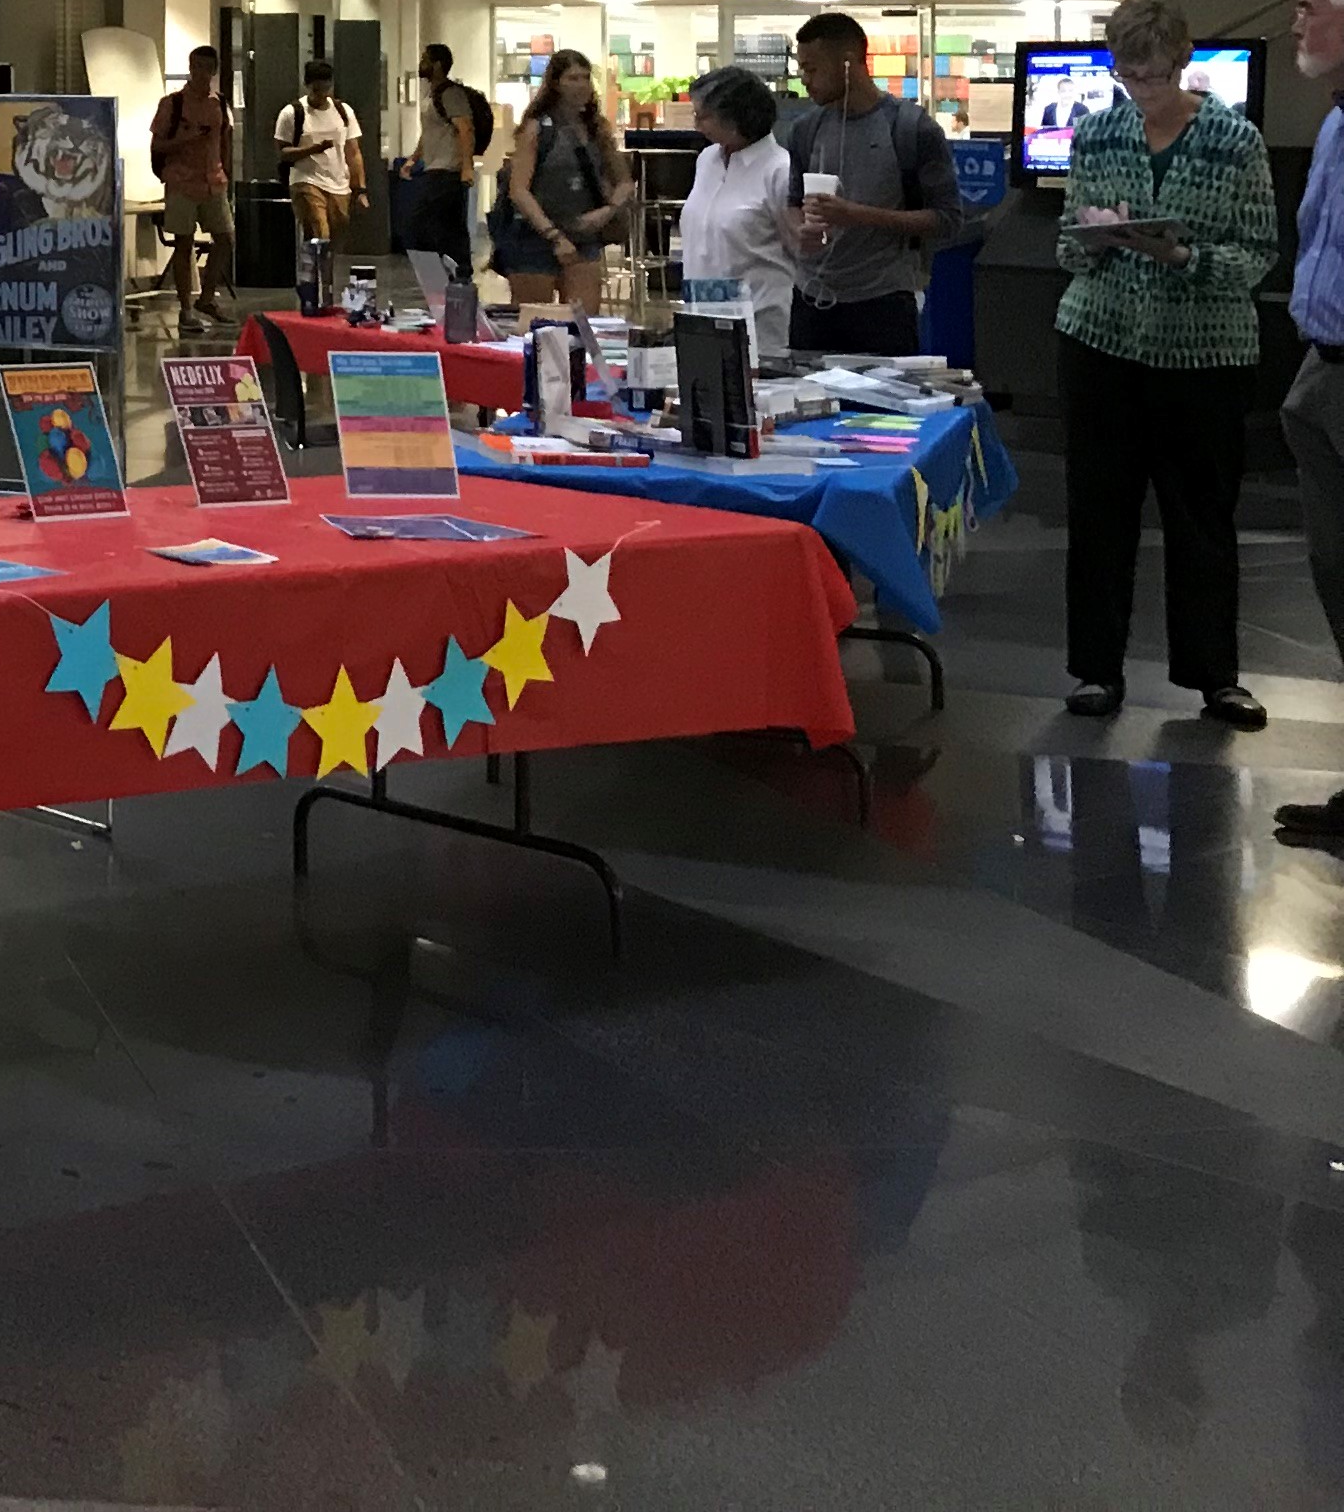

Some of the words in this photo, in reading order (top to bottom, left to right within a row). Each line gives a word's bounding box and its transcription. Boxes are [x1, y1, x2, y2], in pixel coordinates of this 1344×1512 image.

[56, 218, 113, 252] BROS
[37, 259, 68, 273] AND
[169, 364, 226, 386] NEDFLIX
